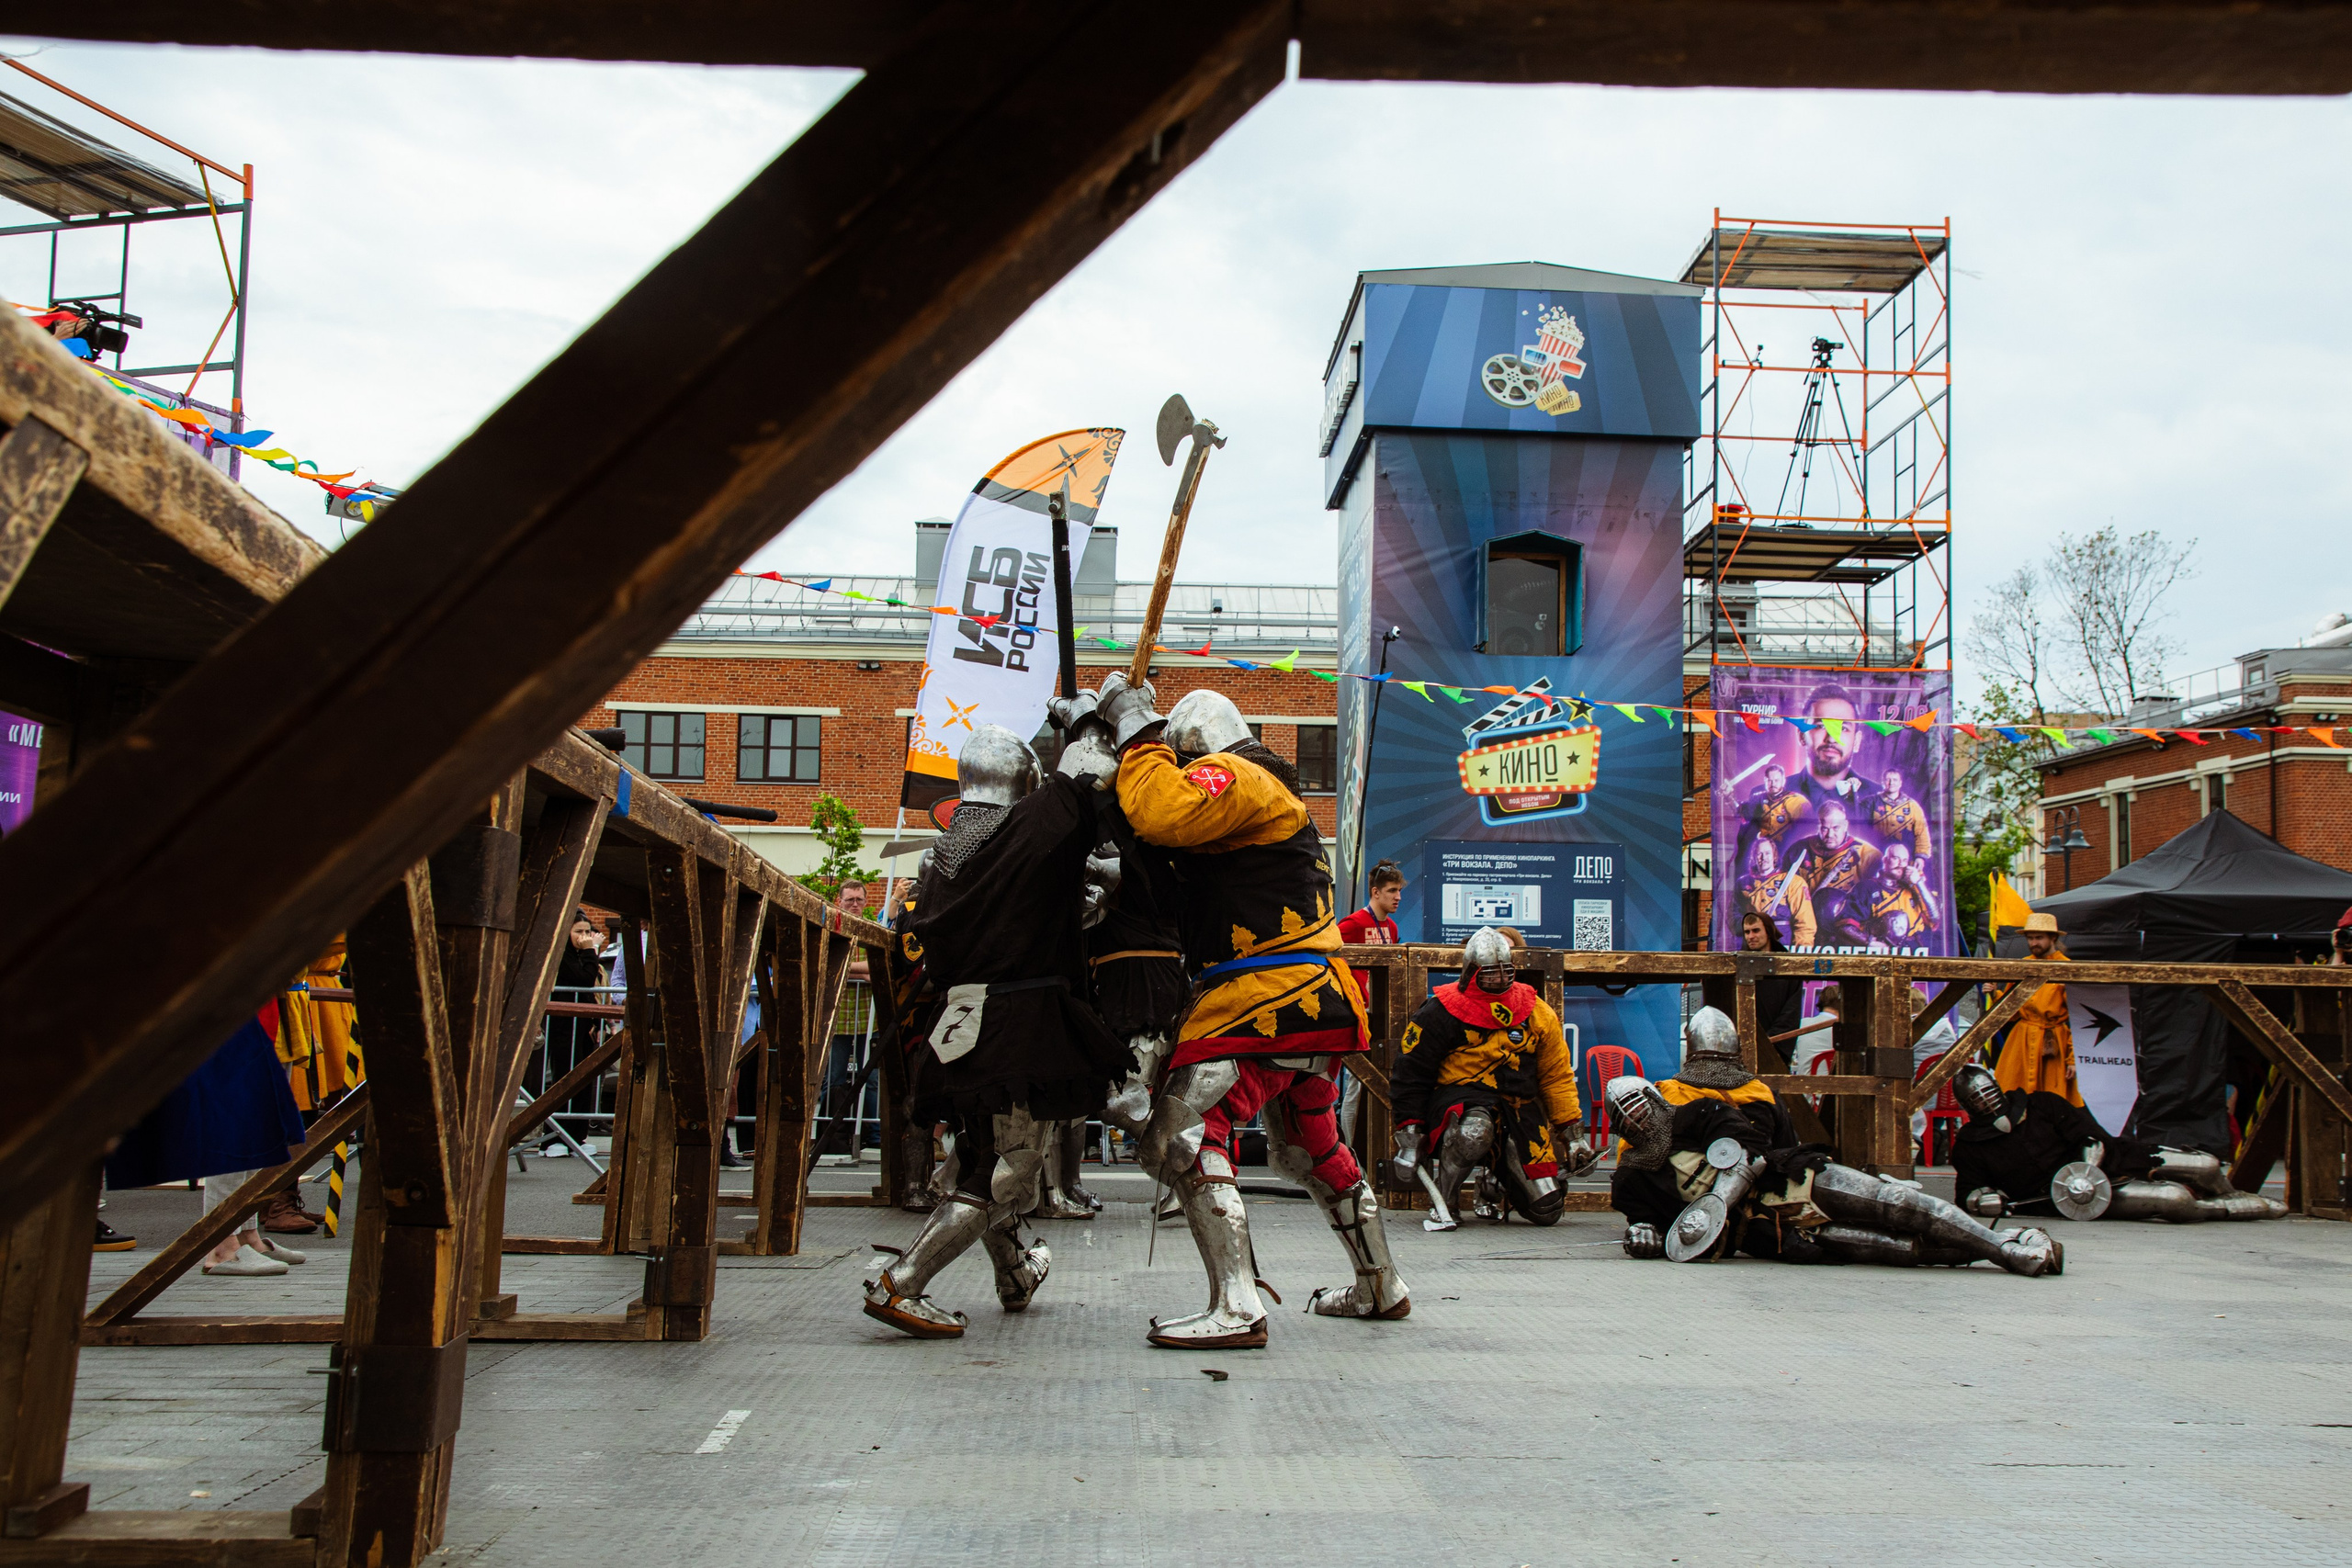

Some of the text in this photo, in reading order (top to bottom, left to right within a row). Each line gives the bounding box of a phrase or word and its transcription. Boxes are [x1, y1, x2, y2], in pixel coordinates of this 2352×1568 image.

[1538, 385, 1564, 406] КИНО
[953, 546, 1023, 667] ИСБ
[1006, 552, 1050, 672] РОССИИ
[1741, 704, 1777, 716] ТУРНИР
[1499, 744, 1559, 784] КИНО
[1521, 794, 1550, 803] ОТКРЫТЫМ
[1573, 856, 1612, 878] ДЕПО
[2078, 1055, 2133, 1066] TRAILHEAD
